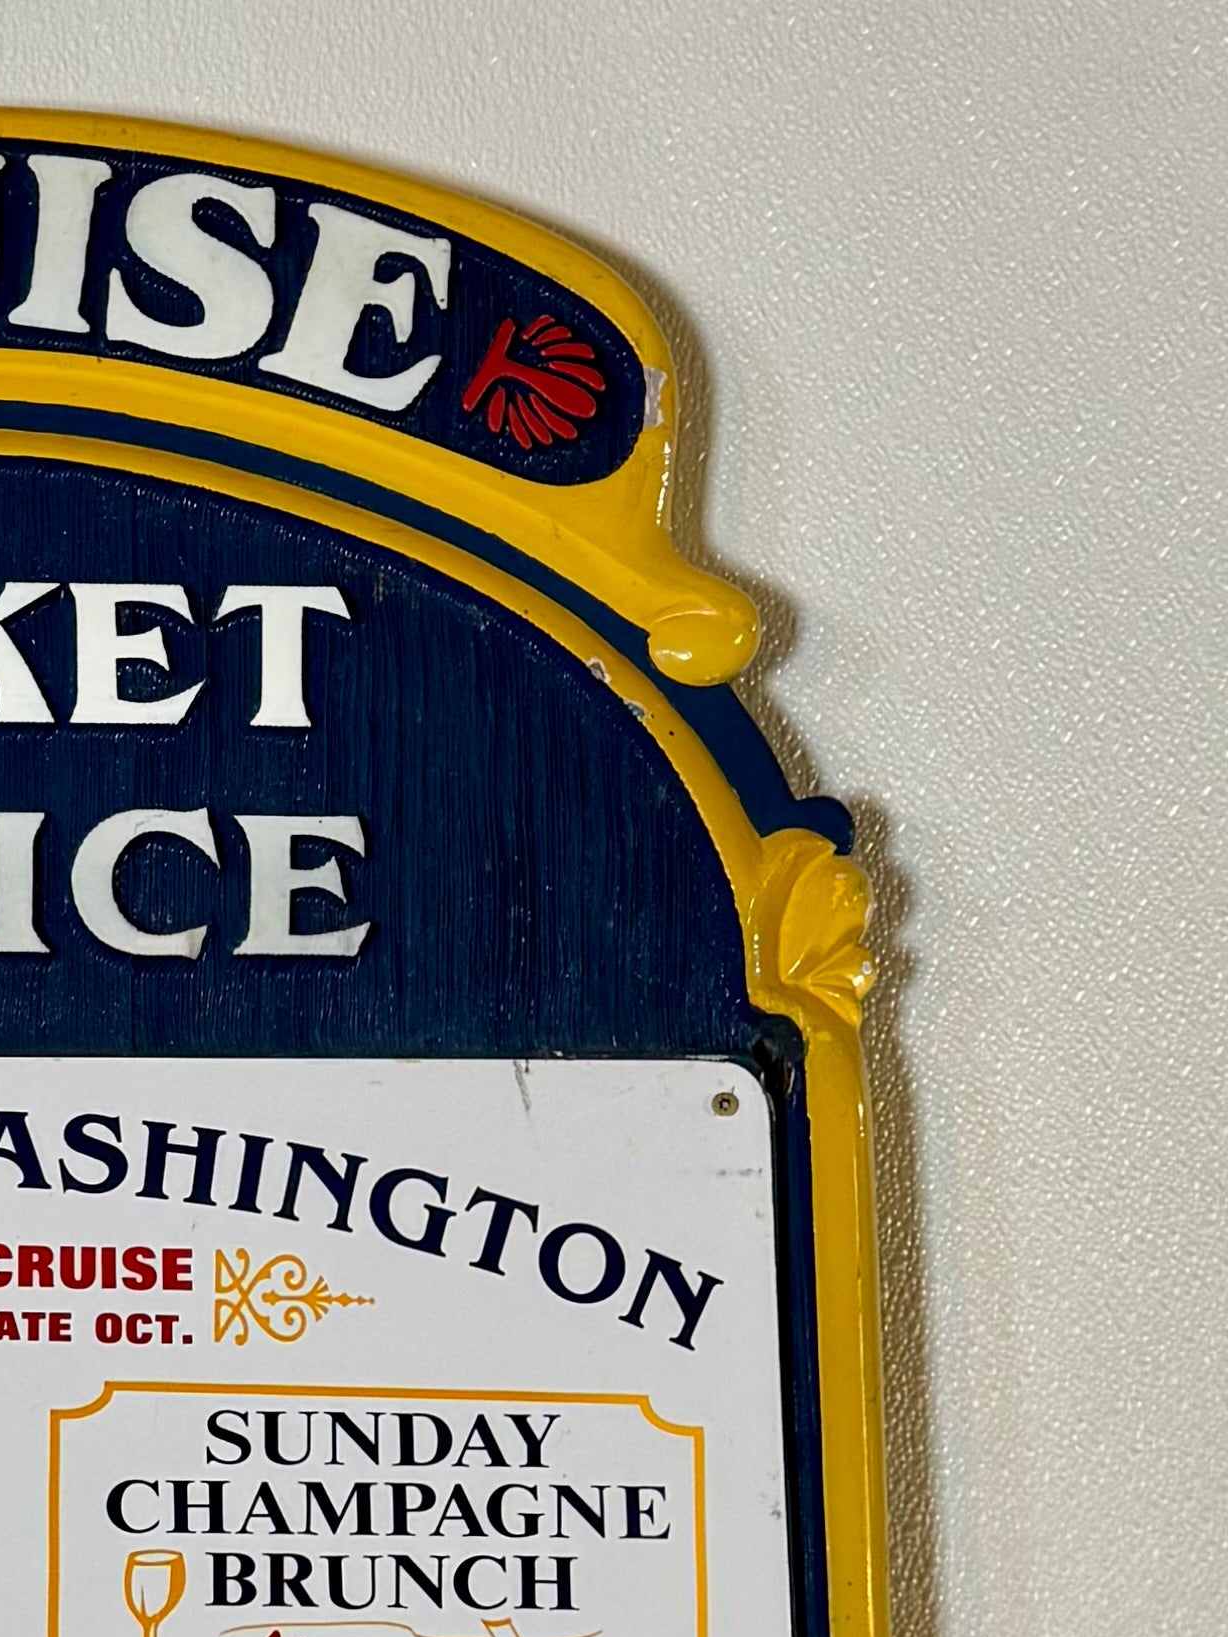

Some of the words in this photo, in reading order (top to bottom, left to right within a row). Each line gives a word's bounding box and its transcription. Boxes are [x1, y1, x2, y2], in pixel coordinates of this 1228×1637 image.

[95, 1312, 194, 1345] OCT.
[207, 1410, 560, 1467] SUNDAY
[107, 1480, 670, 1539] CHAMPAGNE
[206, 1552, 578, 1610] BRUNCH
